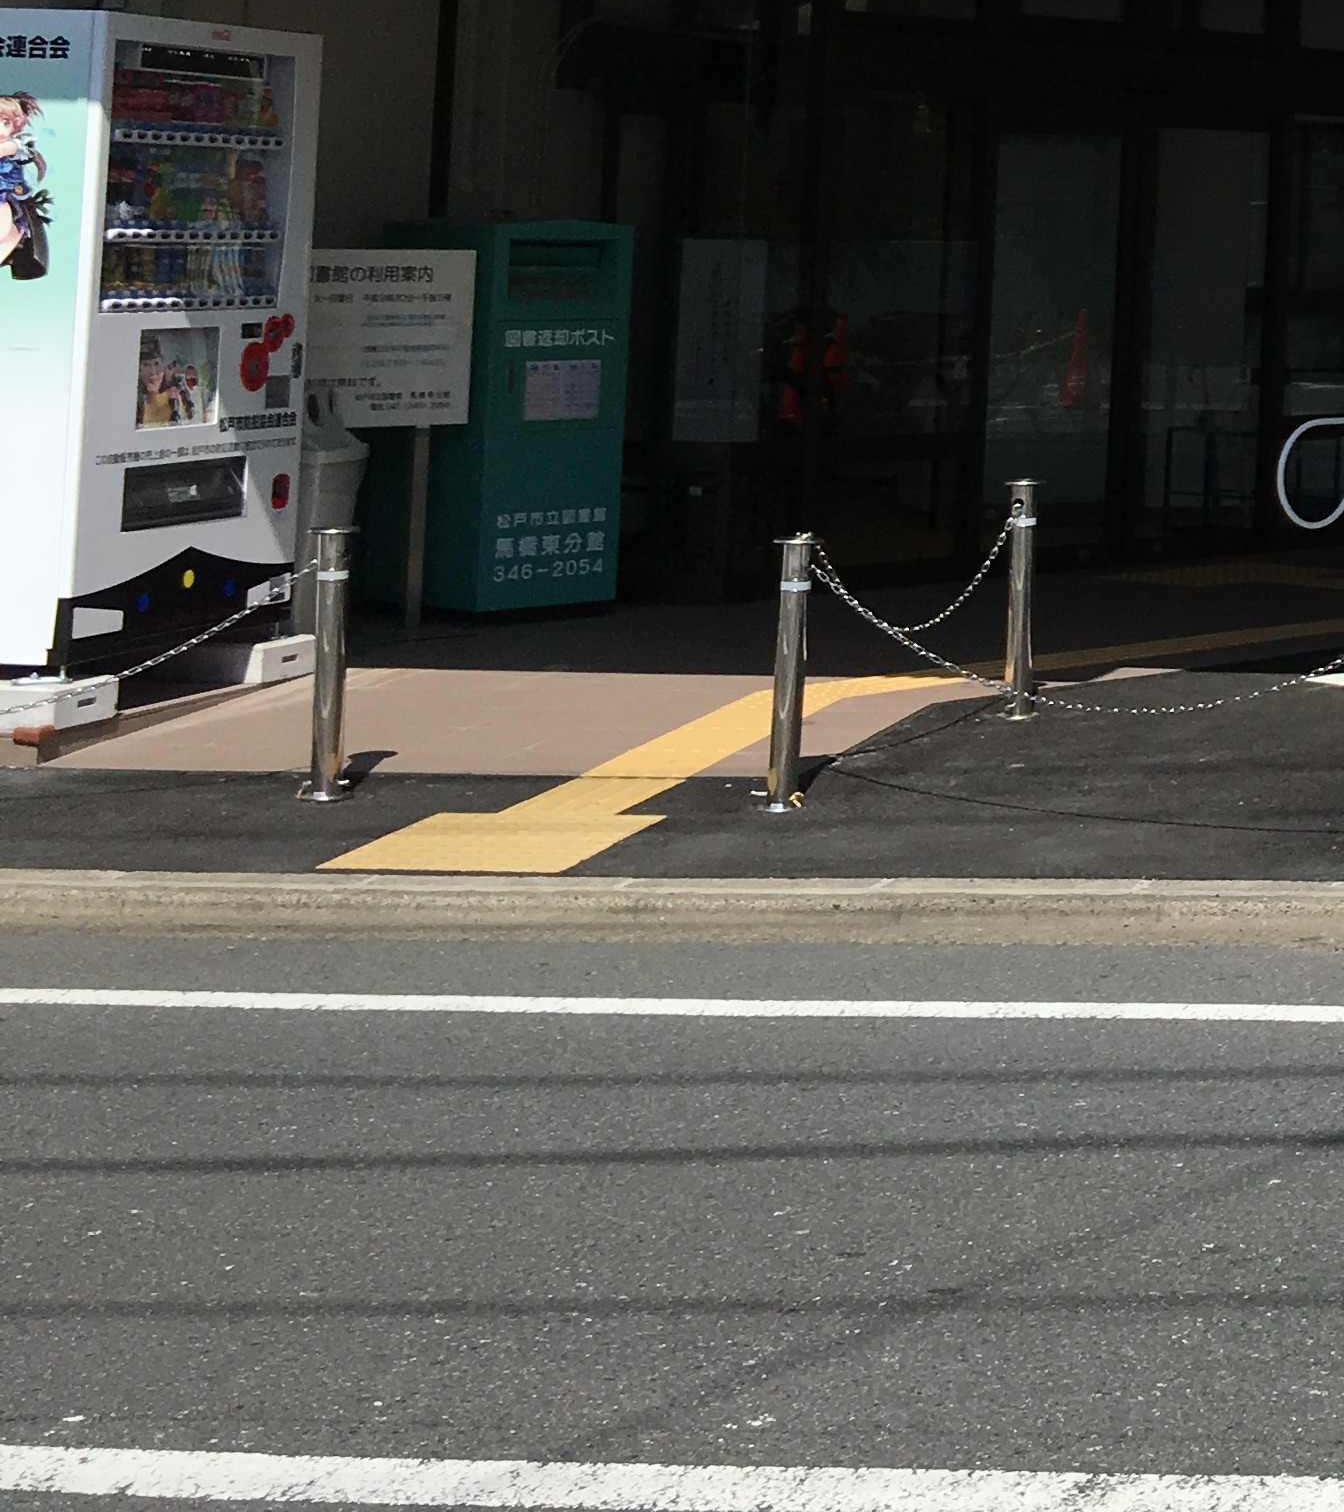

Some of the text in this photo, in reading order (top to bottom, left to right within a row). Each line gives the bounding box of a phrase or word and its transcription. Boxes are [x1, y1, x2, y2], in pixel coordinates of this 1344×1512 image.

[0, 34, 71, 59] 連合会
[310, 265, 434, 284] 書館の利用案内
[504, 329, 615, 347] 図書返却ポスト
[496, 507, 607, 529] 松戸市立図書館
[495, 531, 605, 559] 馬橋東分館
